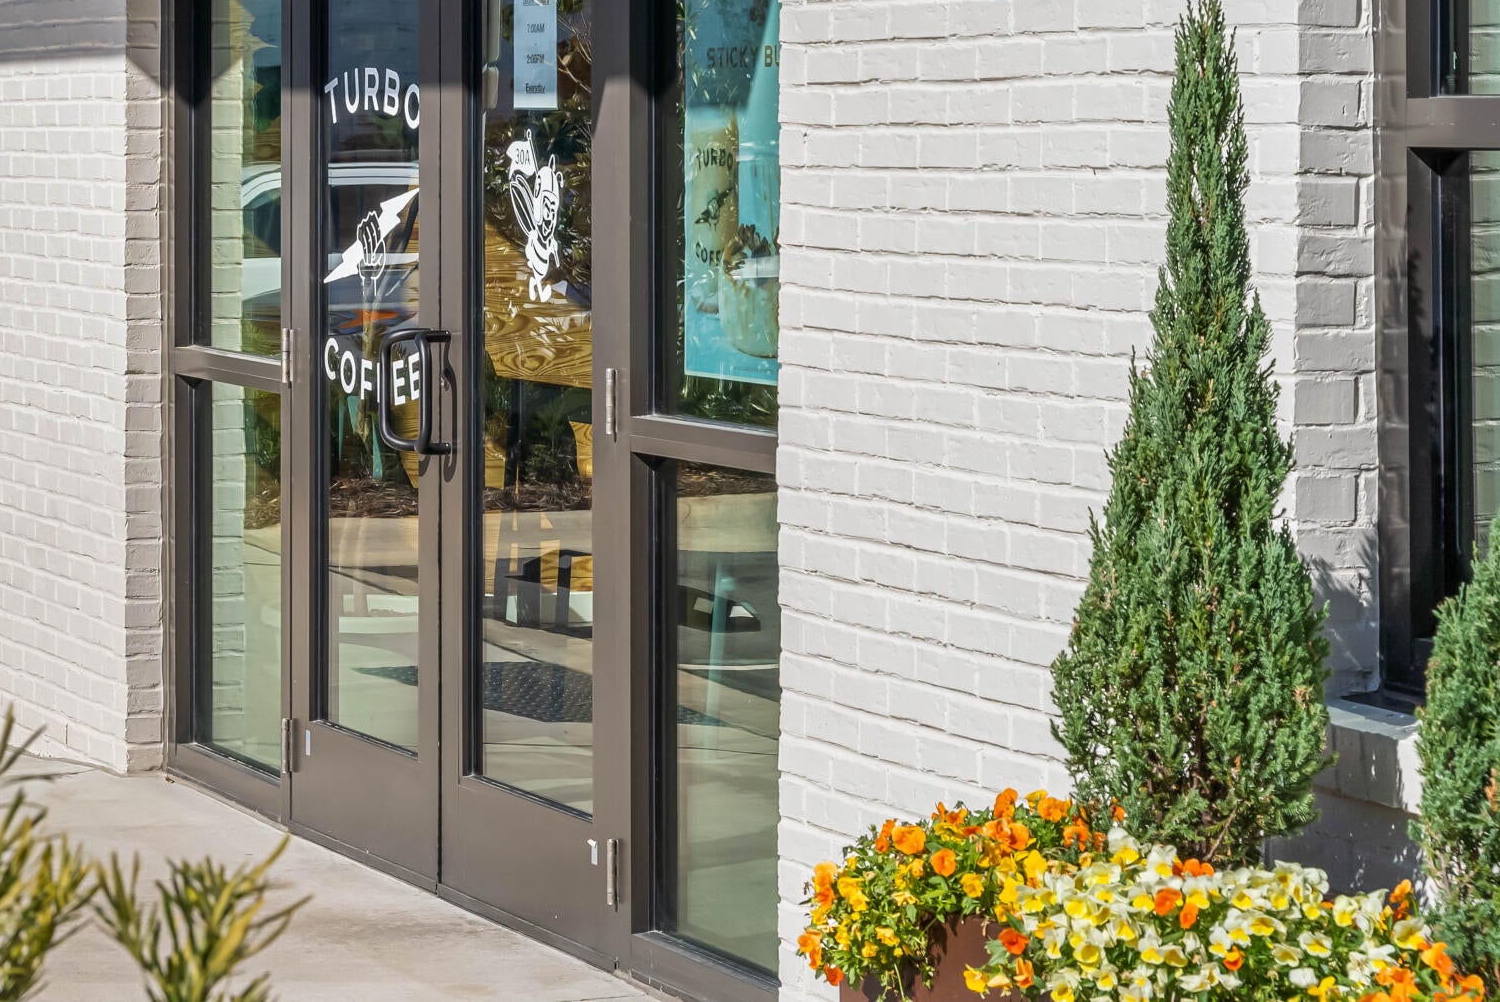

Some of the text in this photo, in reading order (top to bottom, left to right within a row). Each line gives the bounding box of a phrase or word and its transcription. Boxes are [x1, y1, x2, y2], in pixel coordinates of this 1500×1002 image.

[707, 46, 759, 69] STICKY
[324, 67, 420, 130] TURBO
[515, 148, 531, 166] 30A
[697, 148, 734, 171] TURBO
[324, 337, 420, 406] COFEE
